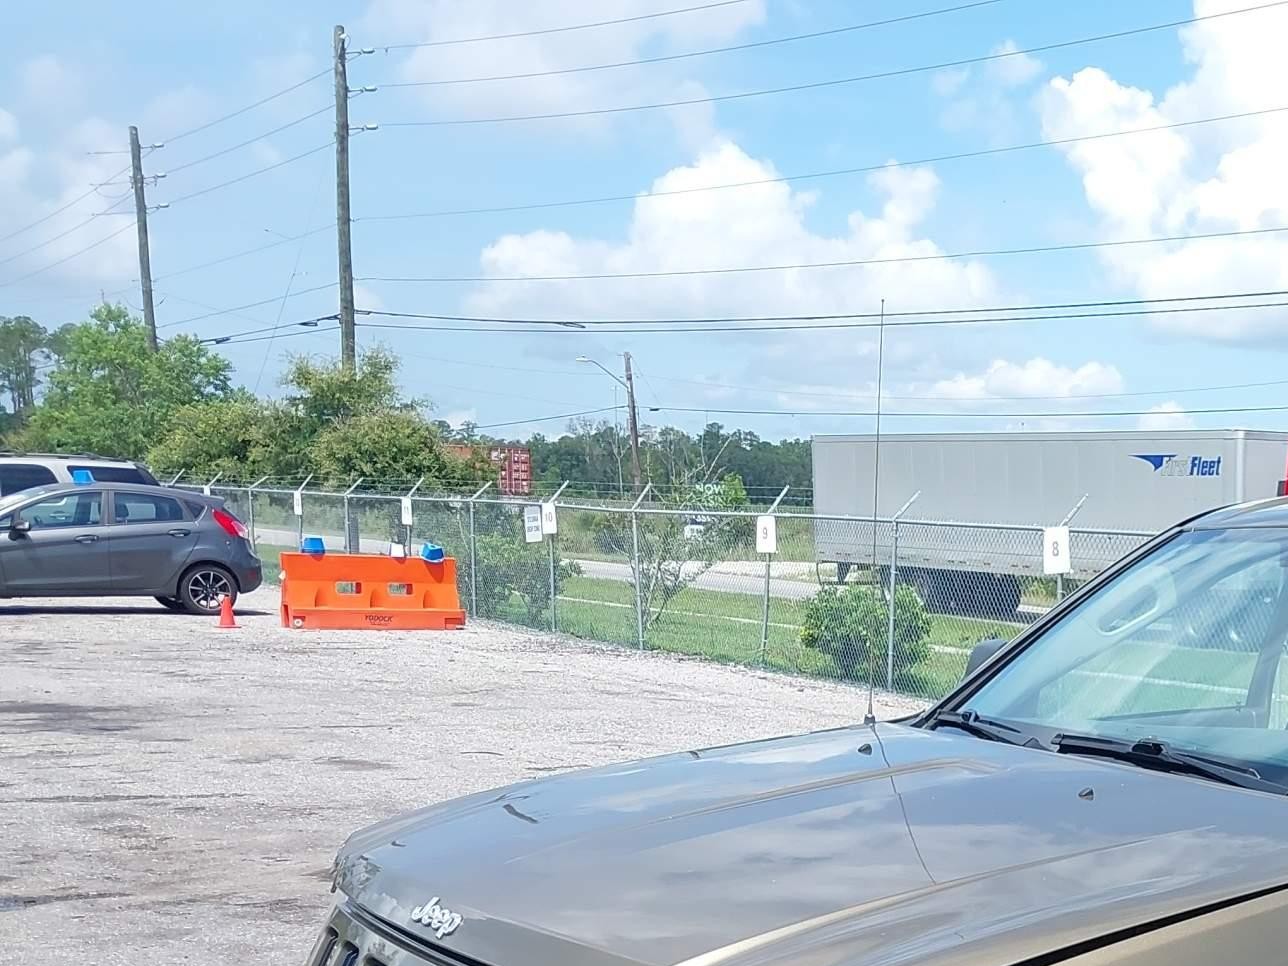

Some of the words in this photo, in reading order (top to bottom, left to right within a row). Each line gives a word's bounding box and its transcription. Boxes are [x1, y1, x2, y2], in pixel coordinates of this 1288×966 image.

[545, 512, 553, 522] 10
[762, 527, 768, 540] 9
[1052, 541, 1060, 557] 8
[411, 897, 463, 939] Jeep
